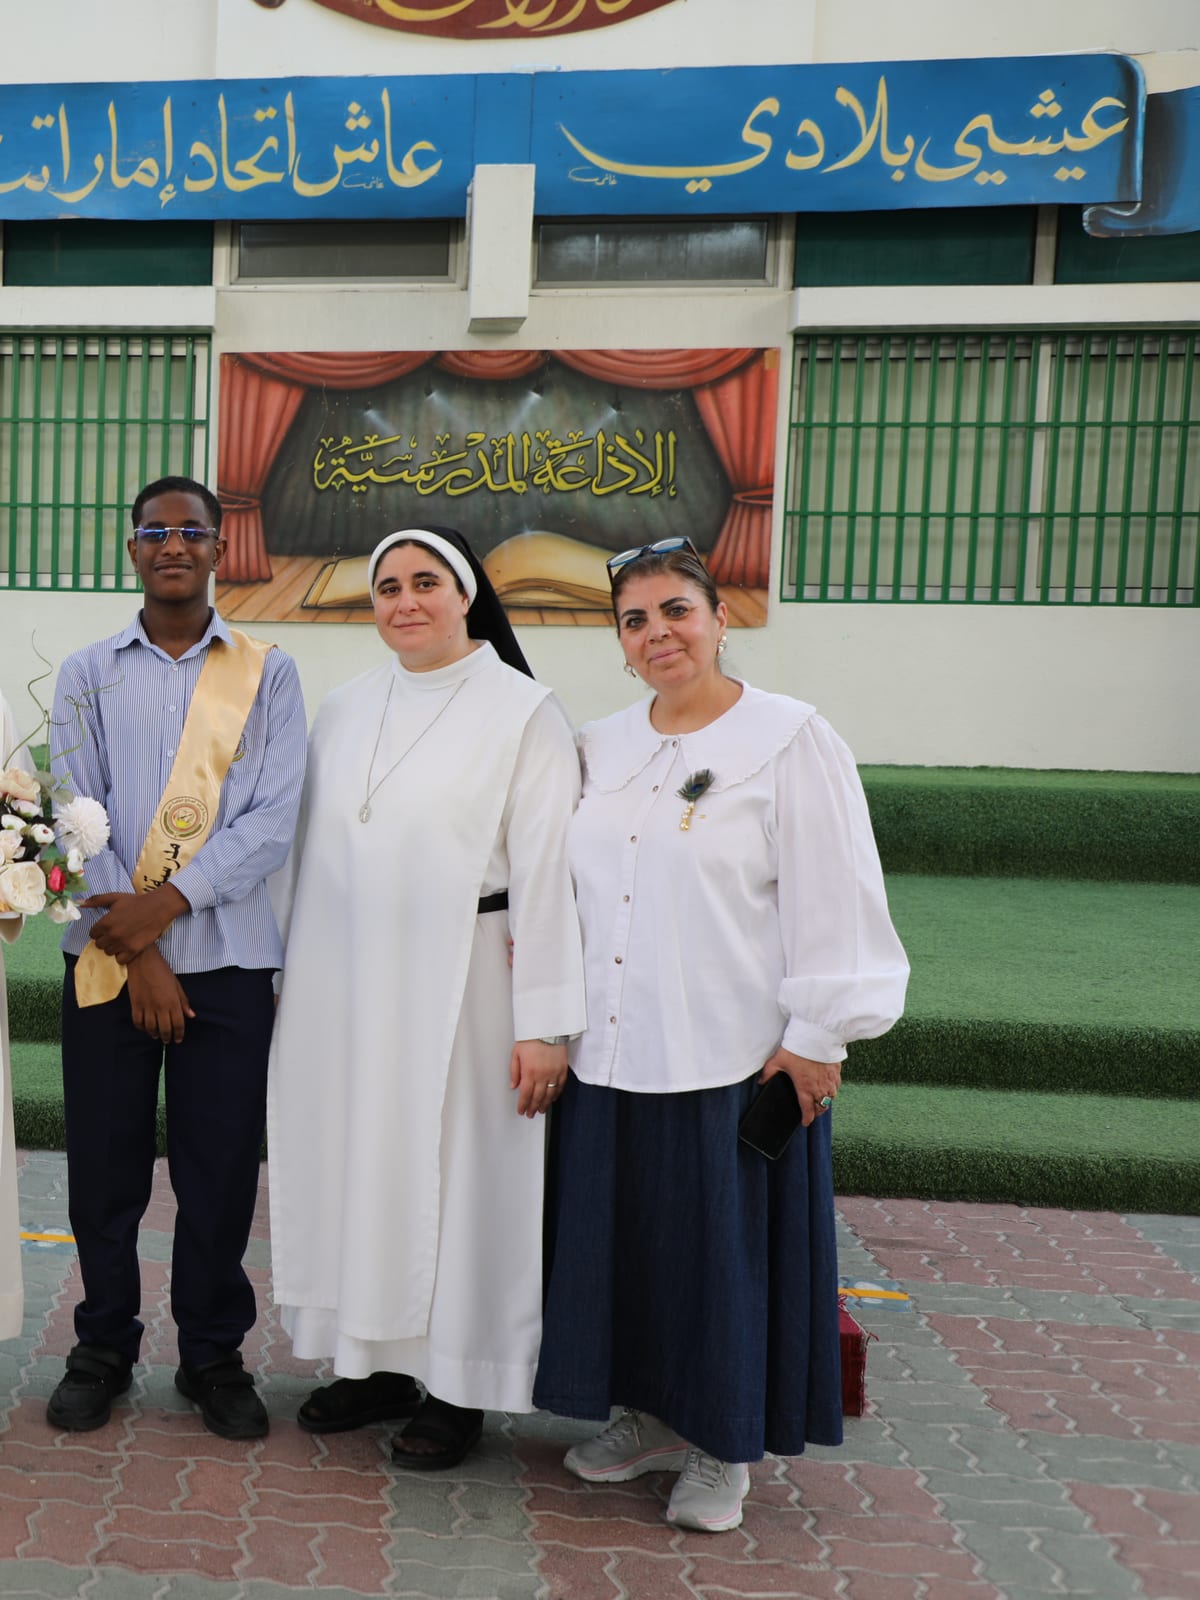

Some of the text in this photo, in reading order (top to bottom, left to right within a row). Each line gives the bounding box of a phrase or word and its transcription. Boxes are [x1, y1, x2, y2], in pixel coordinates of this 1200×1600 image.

[183, 91, 297, 192] اتحاد
[292, 87, 442, 197] عاش
[558, 75, 915, 193] بلادي
[914, 88, 1130, 185] عيشي
